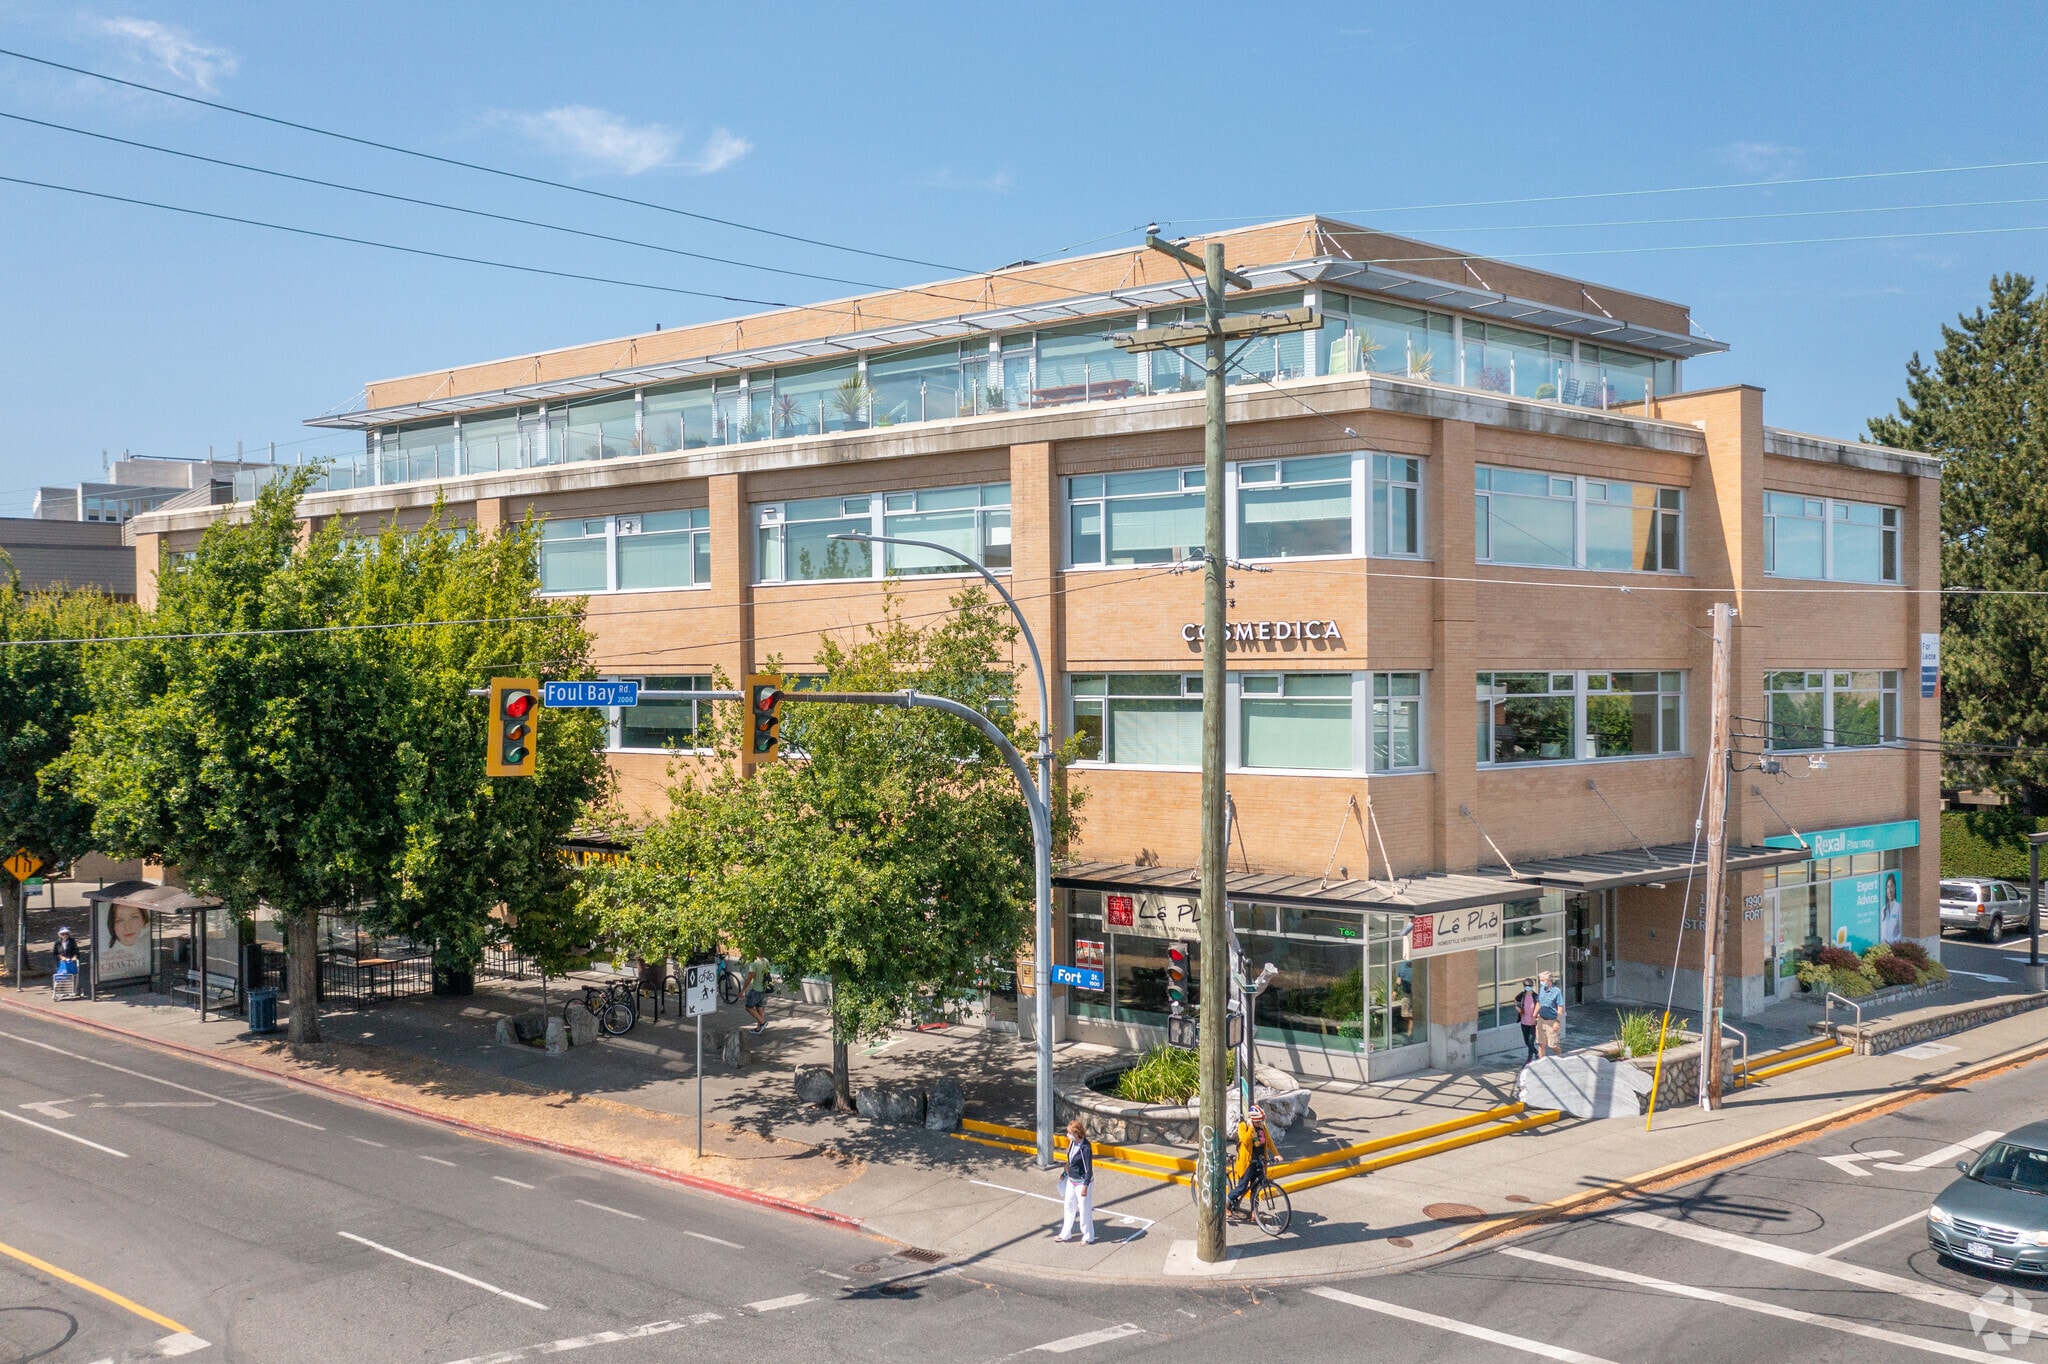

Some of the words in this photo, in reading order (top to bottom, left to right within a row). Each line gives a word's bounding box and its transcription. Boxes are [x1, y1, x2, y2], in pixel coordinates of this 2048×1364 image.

[1922, 642, 1931, 650] For
[1922, 652, 1936, 660] Lease
[548, 684, 583, 701] Foul
[587, 685, 616, 705] Bay
[618, 685, 631, 694] Rd.
[1815, 832, 1846, 856] Rexall
[1847, 838, 1875, 850] Pharmacy
[1857, 880, 1878, 893] Expert
[1745, 894, 1762, 908] 1990
[1139, 900, 1167, 920] Lê
[1744, 908, 1764, 921] FORT
[1437, 914, 1460, 936] Lê
[1467, 908, 1498, 931] Phở
[1339, 927, 1356, 937] Tea
[1438, 939, 1460, 947] HOMESTYLE
[1461, 935, 1483, 943] VIETNAMESE
[1484, 932, 1498, 940] CUISINE
[1057, 968, 1082, 984] Fort
